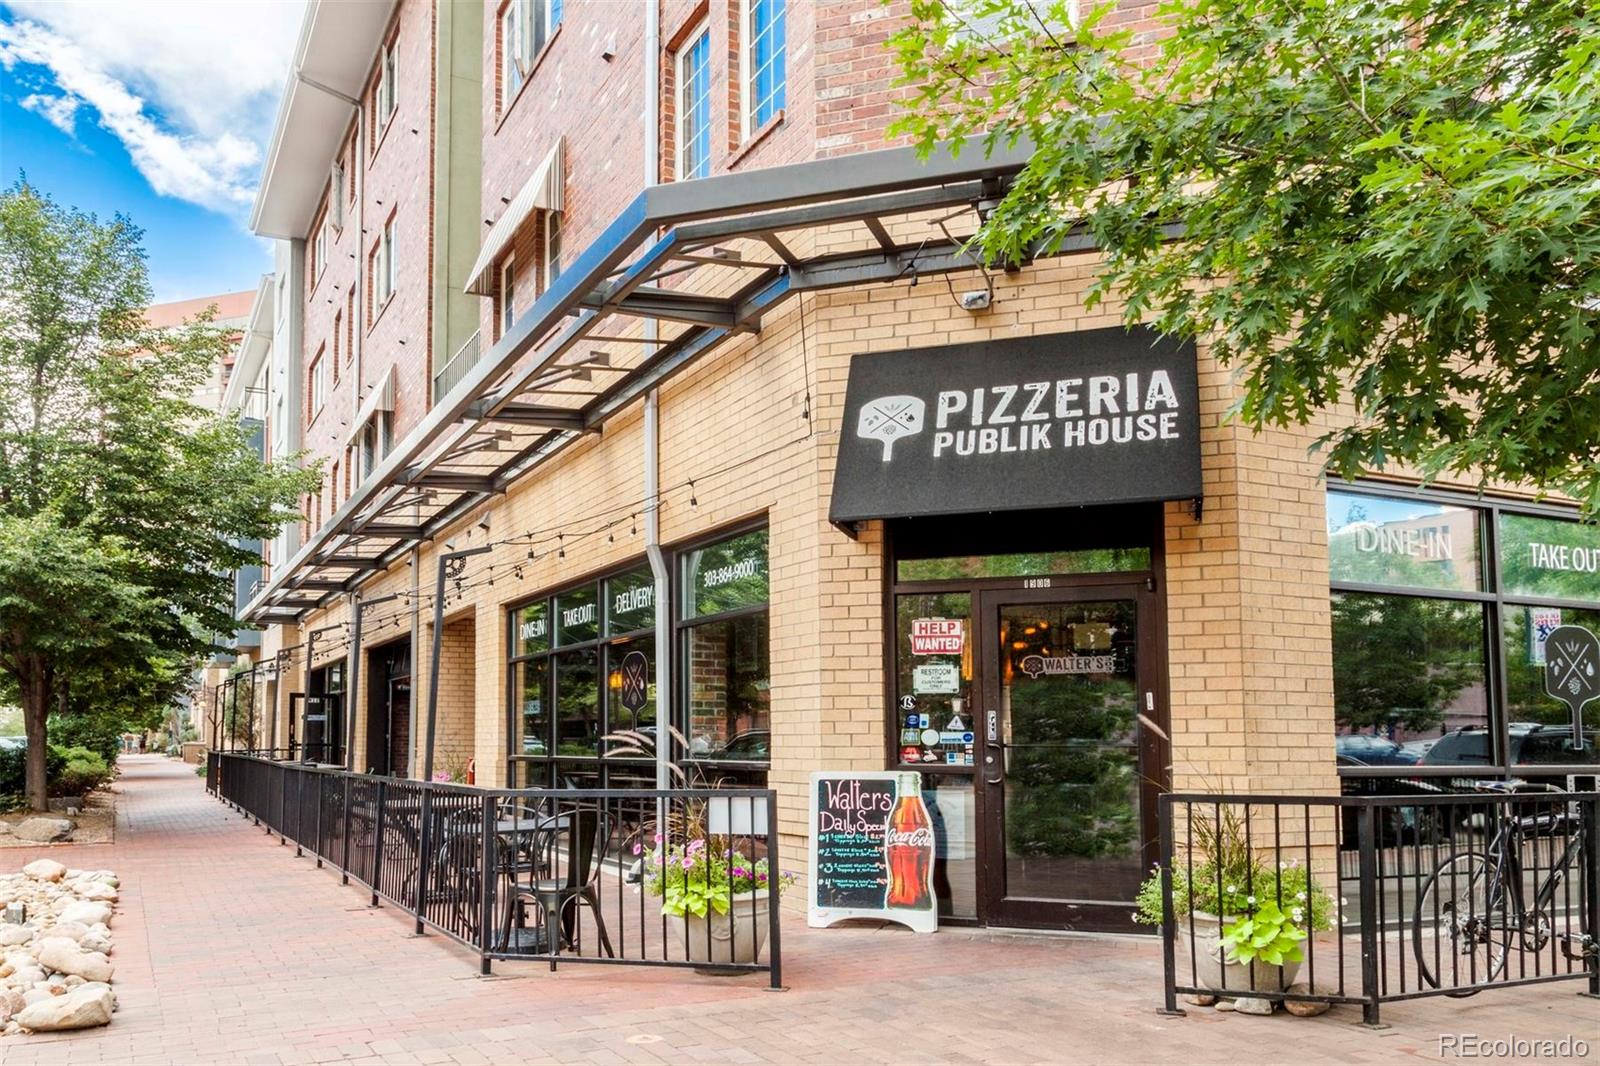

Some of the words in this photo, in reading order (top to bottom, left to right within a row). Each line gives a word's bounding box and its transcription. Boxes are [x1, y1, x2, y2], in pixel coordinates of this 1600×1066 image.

[936, 370, 1179, 428] PIZZERIA
[933, 423, 1051, 458] PUBLIK
[1064, 412, 1179, 447] HOUSE
[1359, 527, 1453, 559] DINE-IN
[1528, 543, 1569, 570] TAKE
[704, 562, 754, 587] 303-864-9000
[616, 585, 653, 614] DELIVERY
[562, 608, 578, 628] TAKE
[578, 604, 594, 624] OUT
[919, 623, 956, 634] HELP
[519, 619, 545, 641] DINE-IN
[915, 637, 960, 650] WANTED
[921, 668, 952, 676] RESTROOM
[1044, 657, 1104, 670] WALTER'S
[825, 780, 893, 811] Walters
[820, 807, 856, 838] Daily
